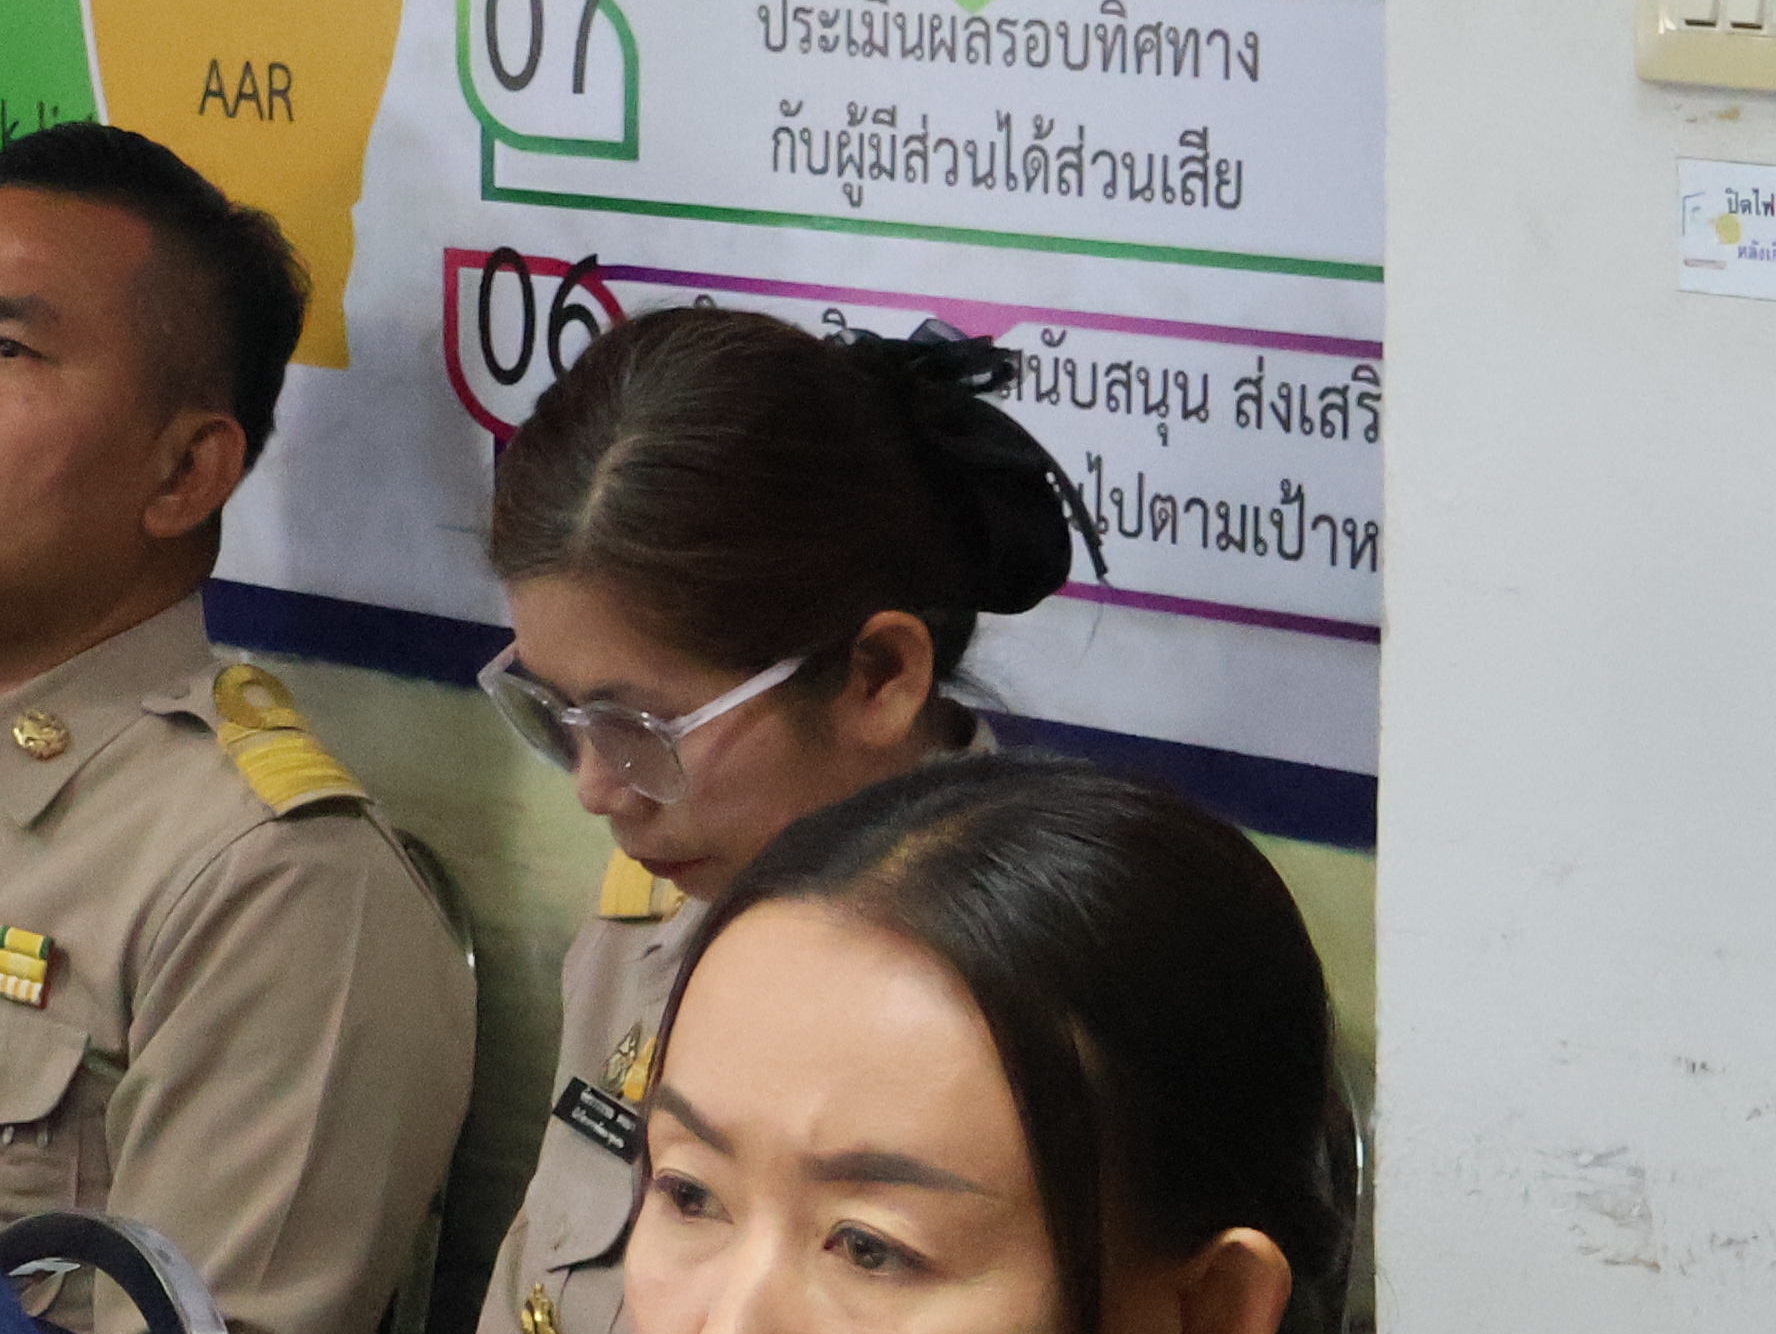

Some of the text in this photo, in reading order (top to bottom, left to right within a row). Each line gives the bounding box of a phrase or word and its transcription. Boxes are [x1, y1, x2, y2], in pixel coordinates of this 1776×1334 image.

[198, 58, 294, 123] AAR
[771, 99, 1245, 211] กับผู้มีส่วนได้ส่วนเสีย
[477, 246, 604, 387] 06
